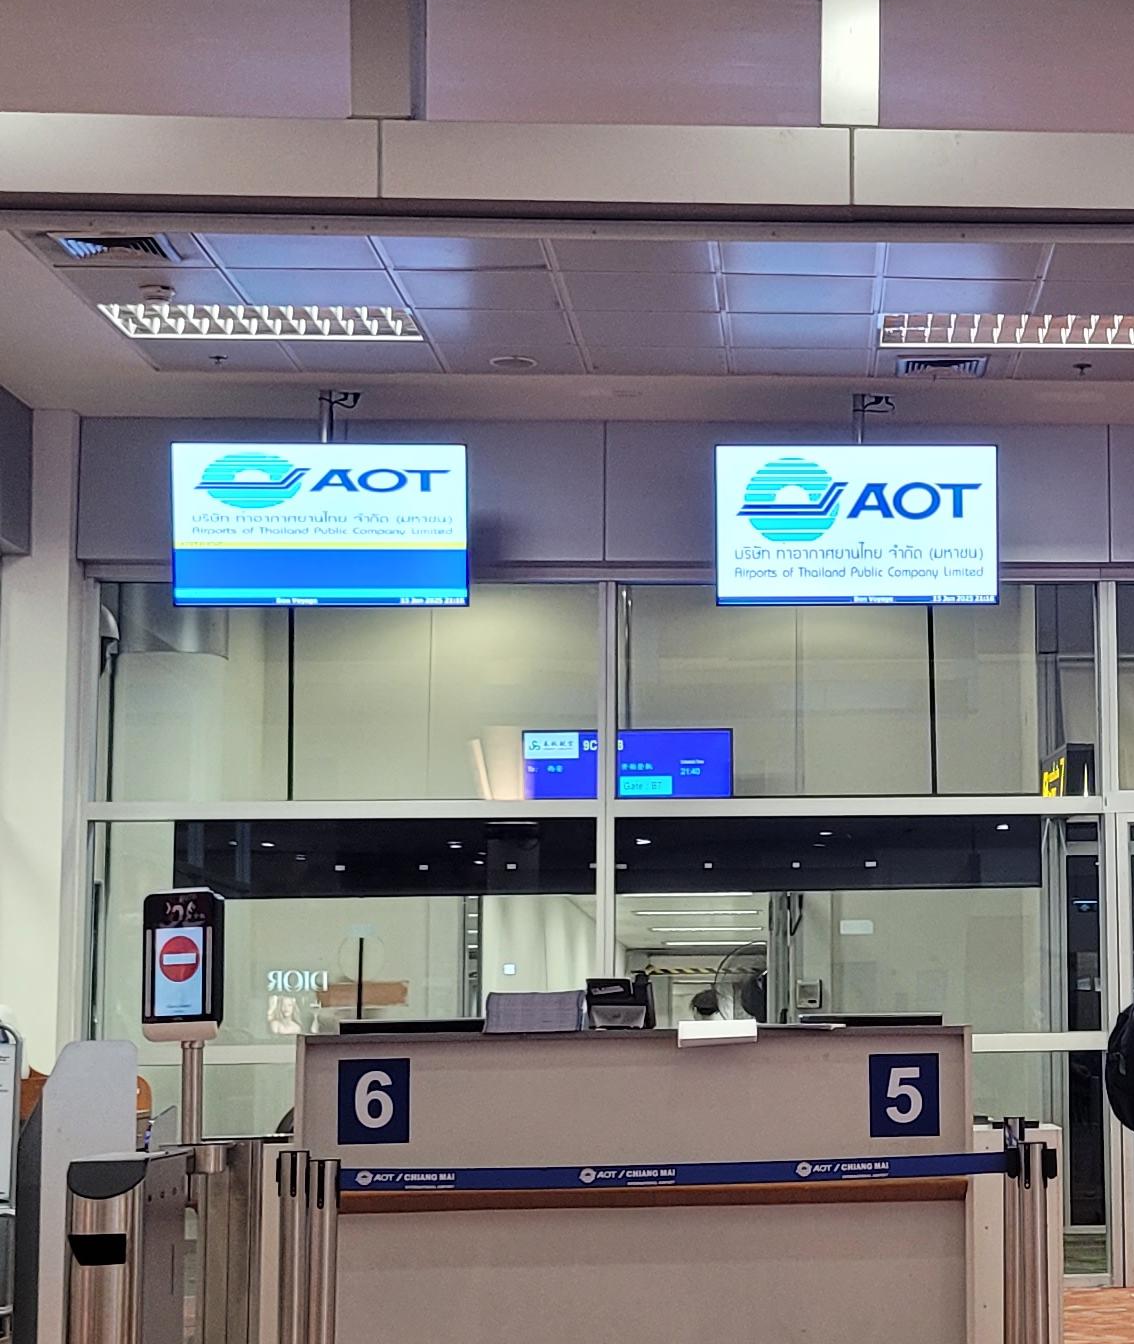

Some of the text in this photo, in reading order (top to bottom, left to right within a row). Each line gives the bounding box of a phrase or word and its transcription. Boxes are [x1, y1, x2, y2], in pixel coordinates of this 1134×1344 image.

[310, 468, 451, 492] AOT
[846, 481, 983, 520] AOT
[192, 526, 453, 536] Airports of Thailand Public Company Limited
[735, 567, 984, 579] Airports of Thailand Public Company Limited
[354, 1070, 394, 1129] 6
[884, 1066, 923, 1124] 5
[813, 1164, 832, 1173] AOT
[841, 1162, 873, 1171] CHIANG
[874, 1162, 889, 1170] MAI
[374, 1174, 395, 1182] AOT
[404, 1173, 438, 1182] CHIANG
[439, 1173, 455, 1181] MAI
[597, 1170, 617, 1178] AOT
[626, 1170, 658, 1178] CHIANG
